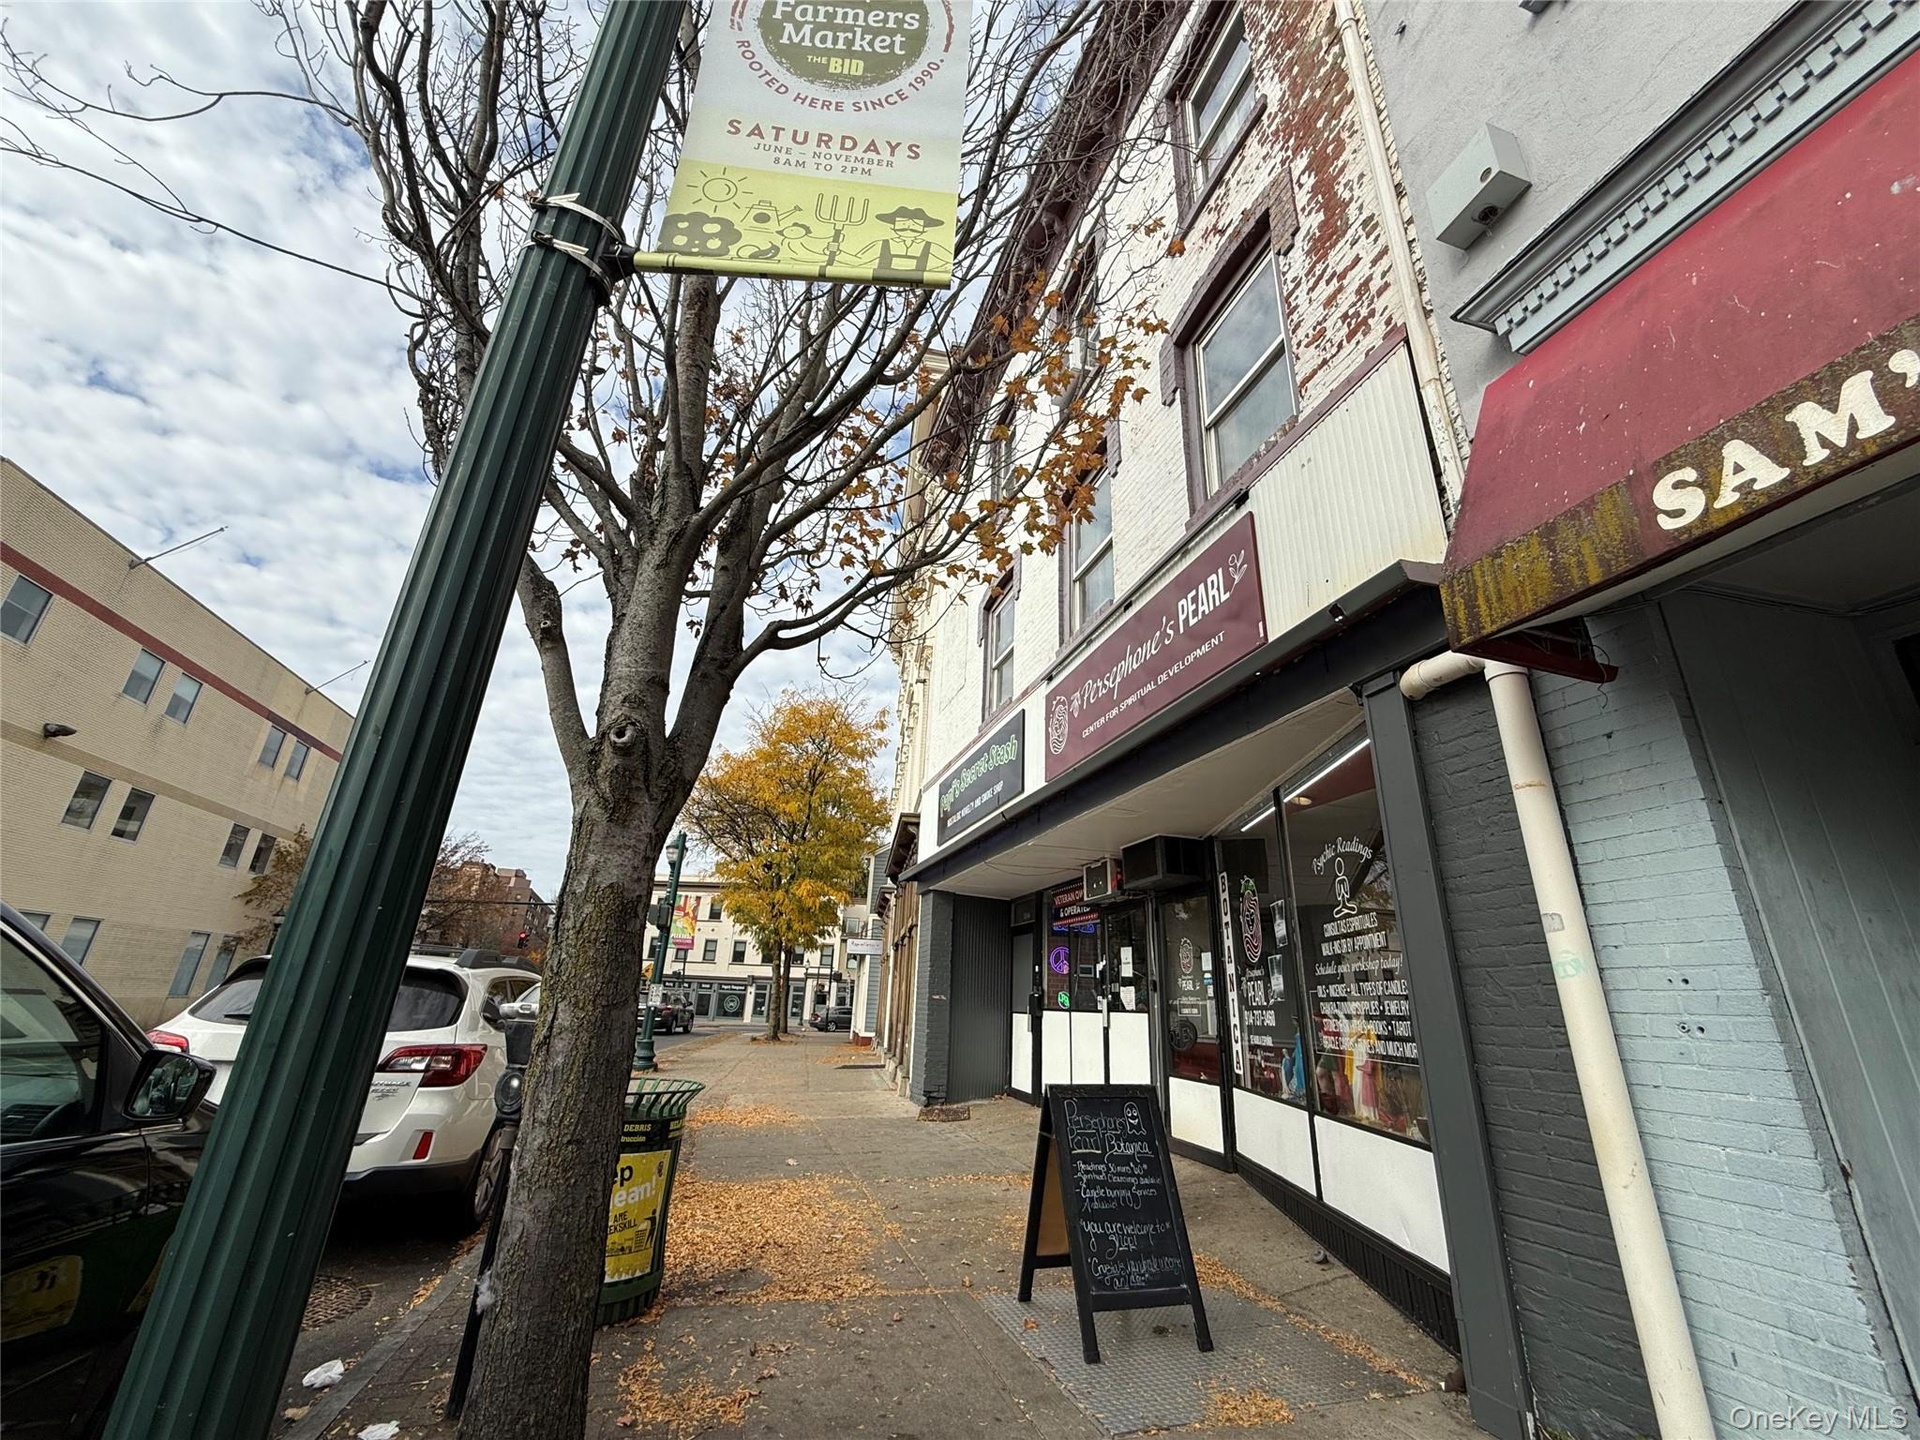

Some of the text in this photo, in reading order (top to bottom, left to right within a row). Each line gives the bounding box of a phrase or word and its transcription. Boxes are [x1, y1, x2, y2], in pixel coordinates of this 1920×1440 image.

[772, 0, 921, 30] Farmers
[779, 22, 906, 55] Market
[736, 39, 790, 96] ROOTED
[793, 92, 845, 112] HERE
[852, 88, 909, 112] SINCE
[806, 55, 865, 76] THE BID
[726, 118, 922, 160] SATURDAYS
[753, 142, 894, 168] JUNE NOVEMBER
[773, 156, 872, 176] 8AM TO 2PM
[1079, 566, 1231, 710] Persephone's PEARL
[1082, 630, 1226, 739] CENTER FOR SPIRITUAL DEVELOPMENT
[1336, 835, 1373, 863] Readings
[1219, 875, 1242, 1072] BOTANICA
[1247, 980, 1267, 1006] PEARL
[1360, 982, 1376, 996] TYPES
[1384, 1000, 1410, 1016] JEWELRY
[1391, 1021, 1412, 1037] TAROT
[1404, 1042, 1419, 1059] MOR
[624, 1124, 652, 1132] DEBRIS
[613, 1210, 628, 1223] ARE
